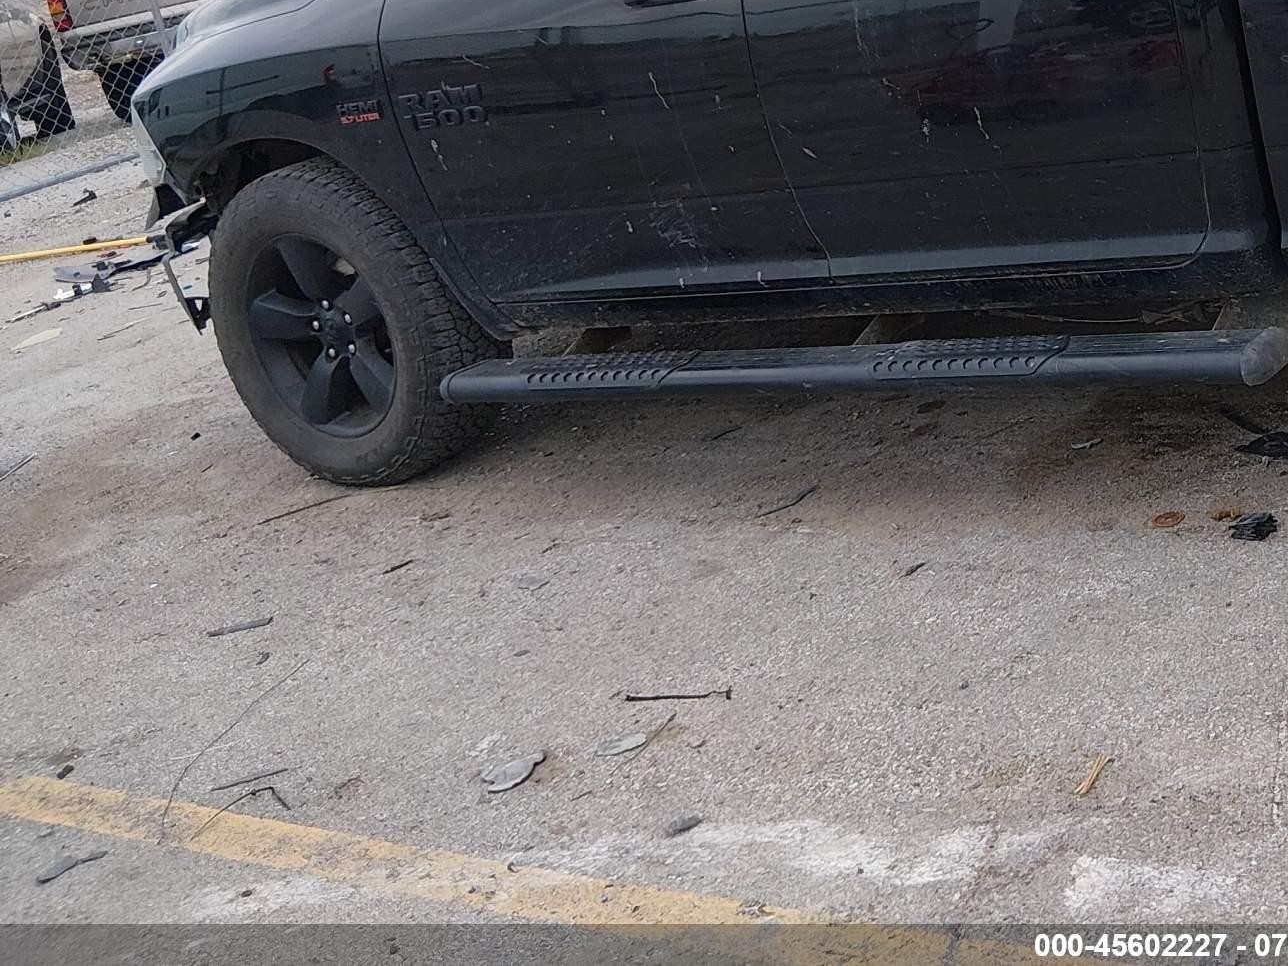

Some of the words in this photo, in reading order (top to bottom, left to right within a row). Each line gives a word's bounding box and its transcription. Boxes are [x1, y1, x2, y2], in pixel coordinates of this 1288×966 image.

[398, 84, 483, 111] RAM
[336, 100, 379, 116] HEMI
[355, 112, 381, 123] LITER
[403, 105, 487, 130] 1500
